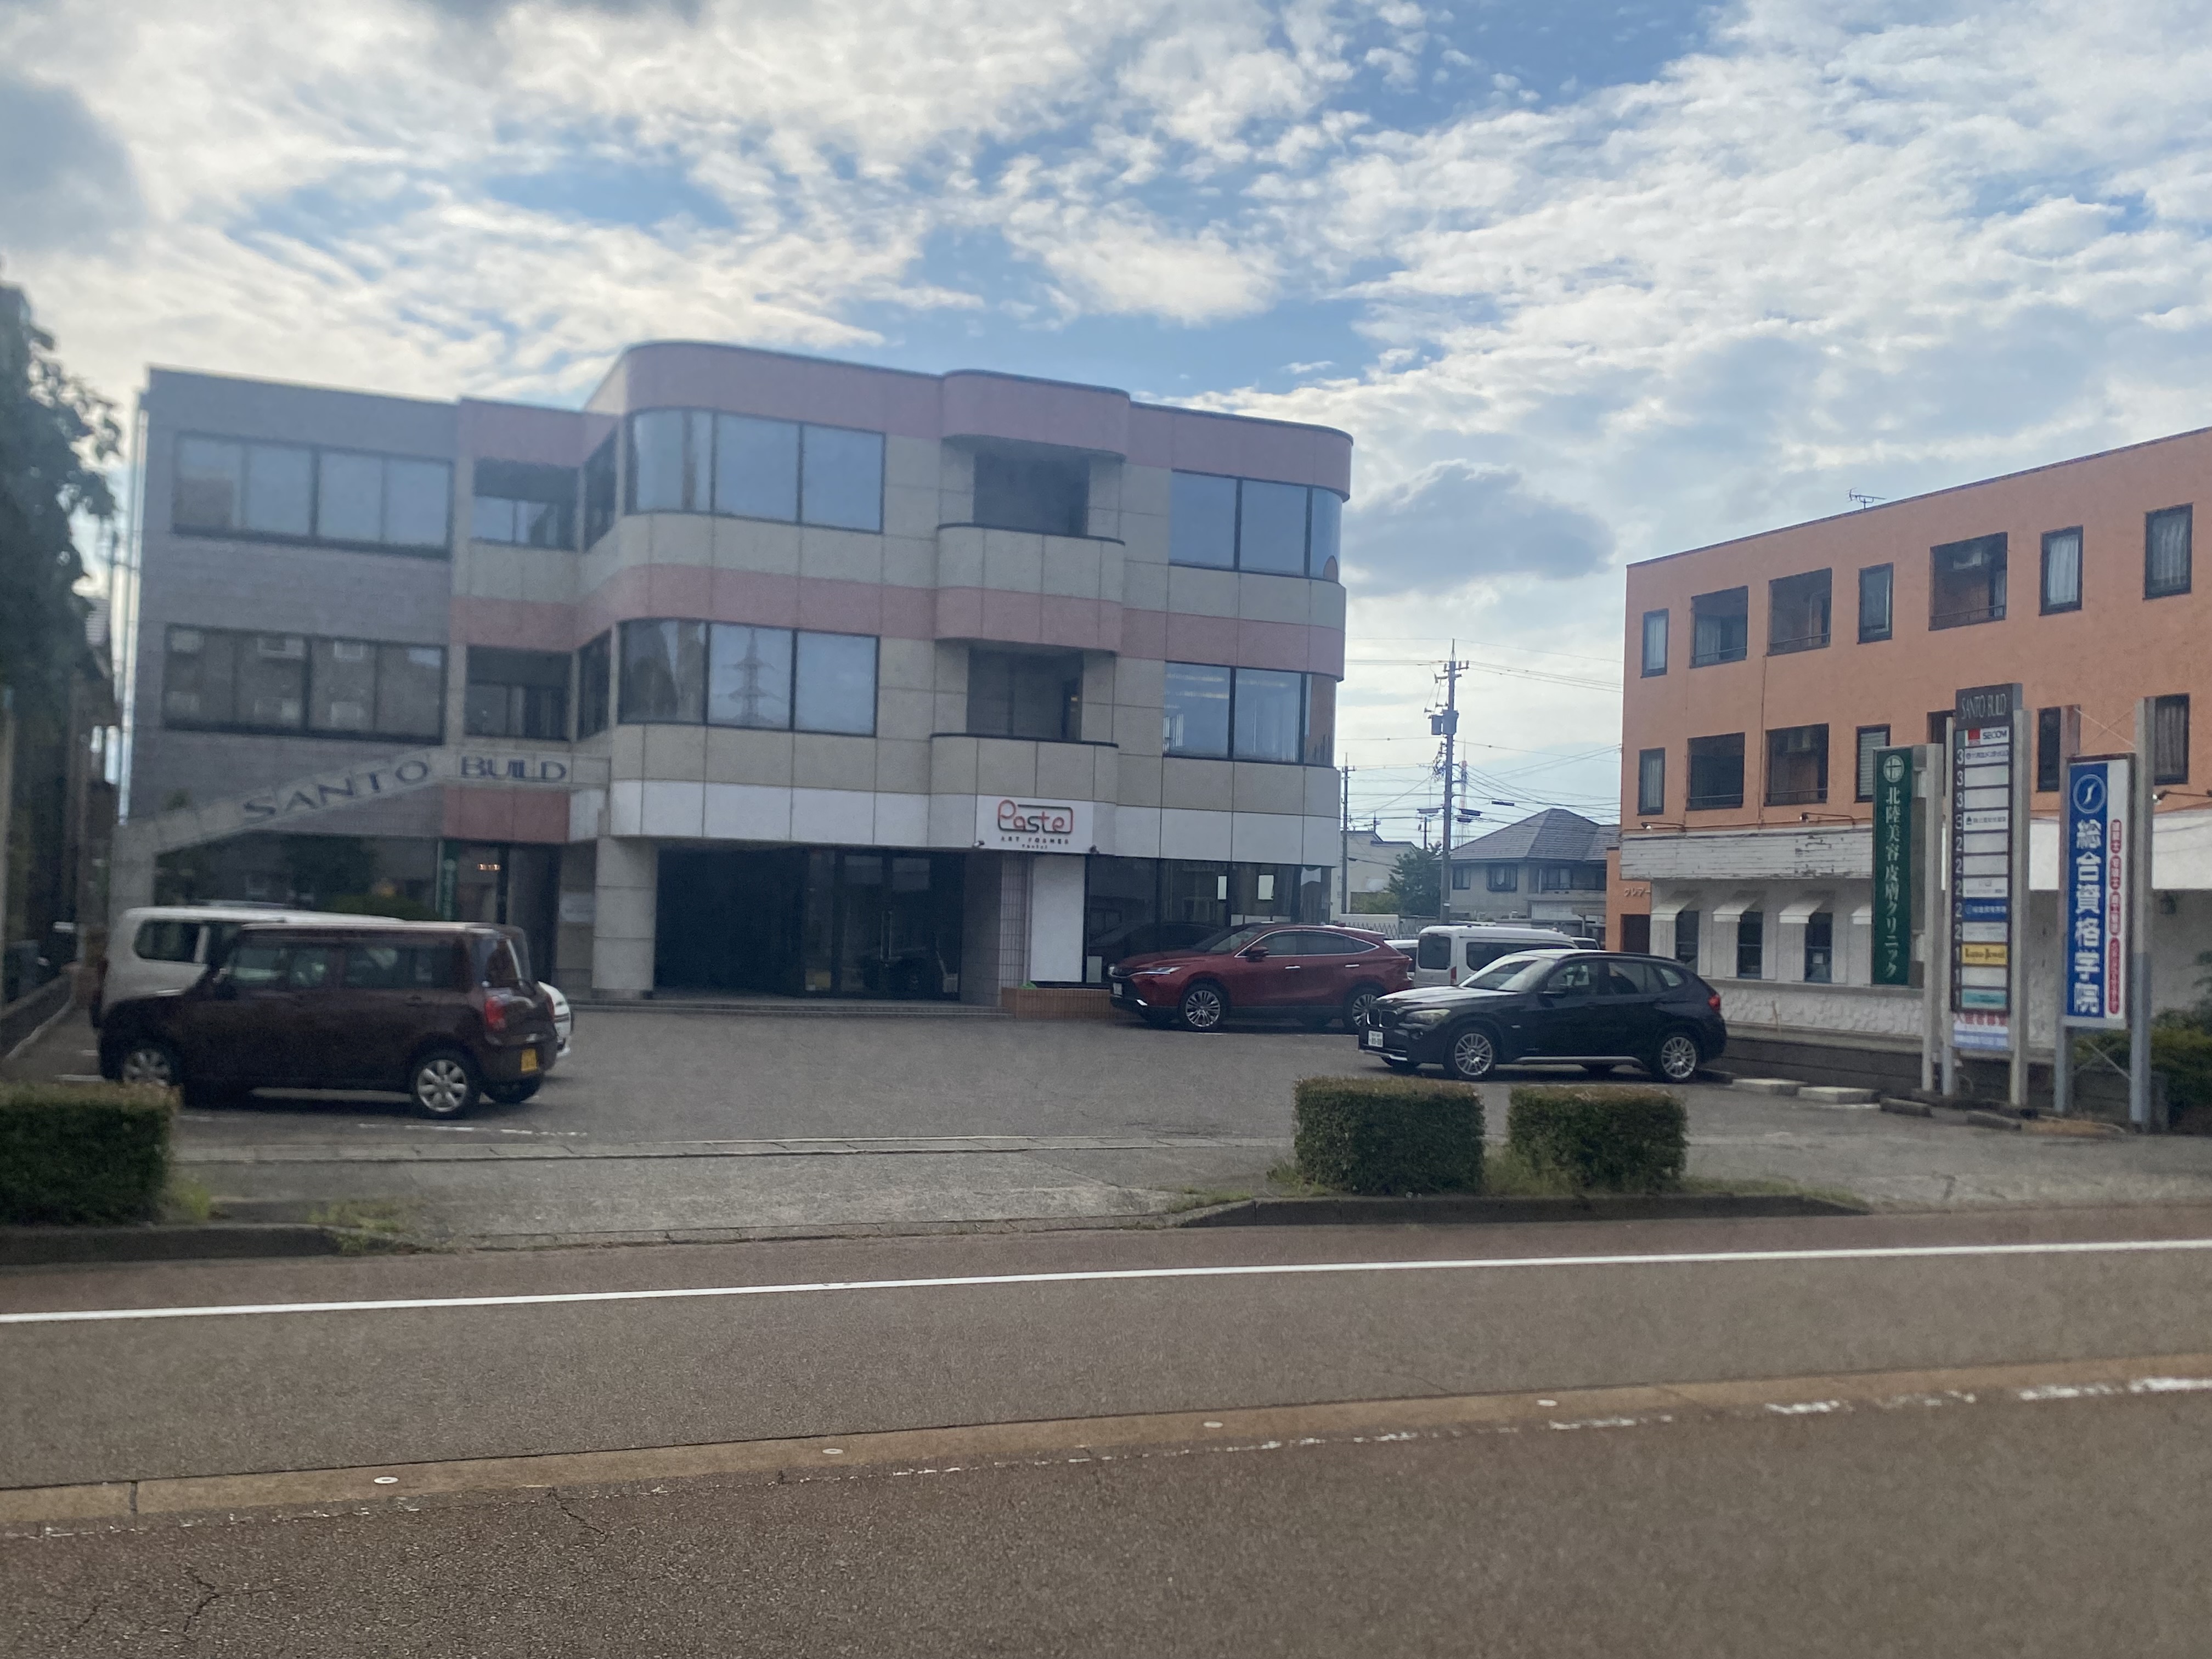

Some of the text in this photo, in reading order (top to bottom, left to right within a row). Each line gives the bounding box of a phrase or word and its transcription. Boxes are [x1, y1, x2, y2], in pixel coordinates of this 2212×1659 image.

[1961, 695, 1985, 719] SANTO
[1983, 730, 2007, 740] SECOM
[1956, 749, 1964, 765] 3
[242, 756, 567, 816] SANTO BUILD
[1957, 771, 1963, 786] 3
[1956, 792, 1963, 807] 3
[1956, 837, 1962, 851] 2
[1955, 858, 1962, 873] 2
[1955, 881, 1962, 895] 2
[1955, 902, 1962, 917] 2
[1955, 924, 1962, 939] 2
